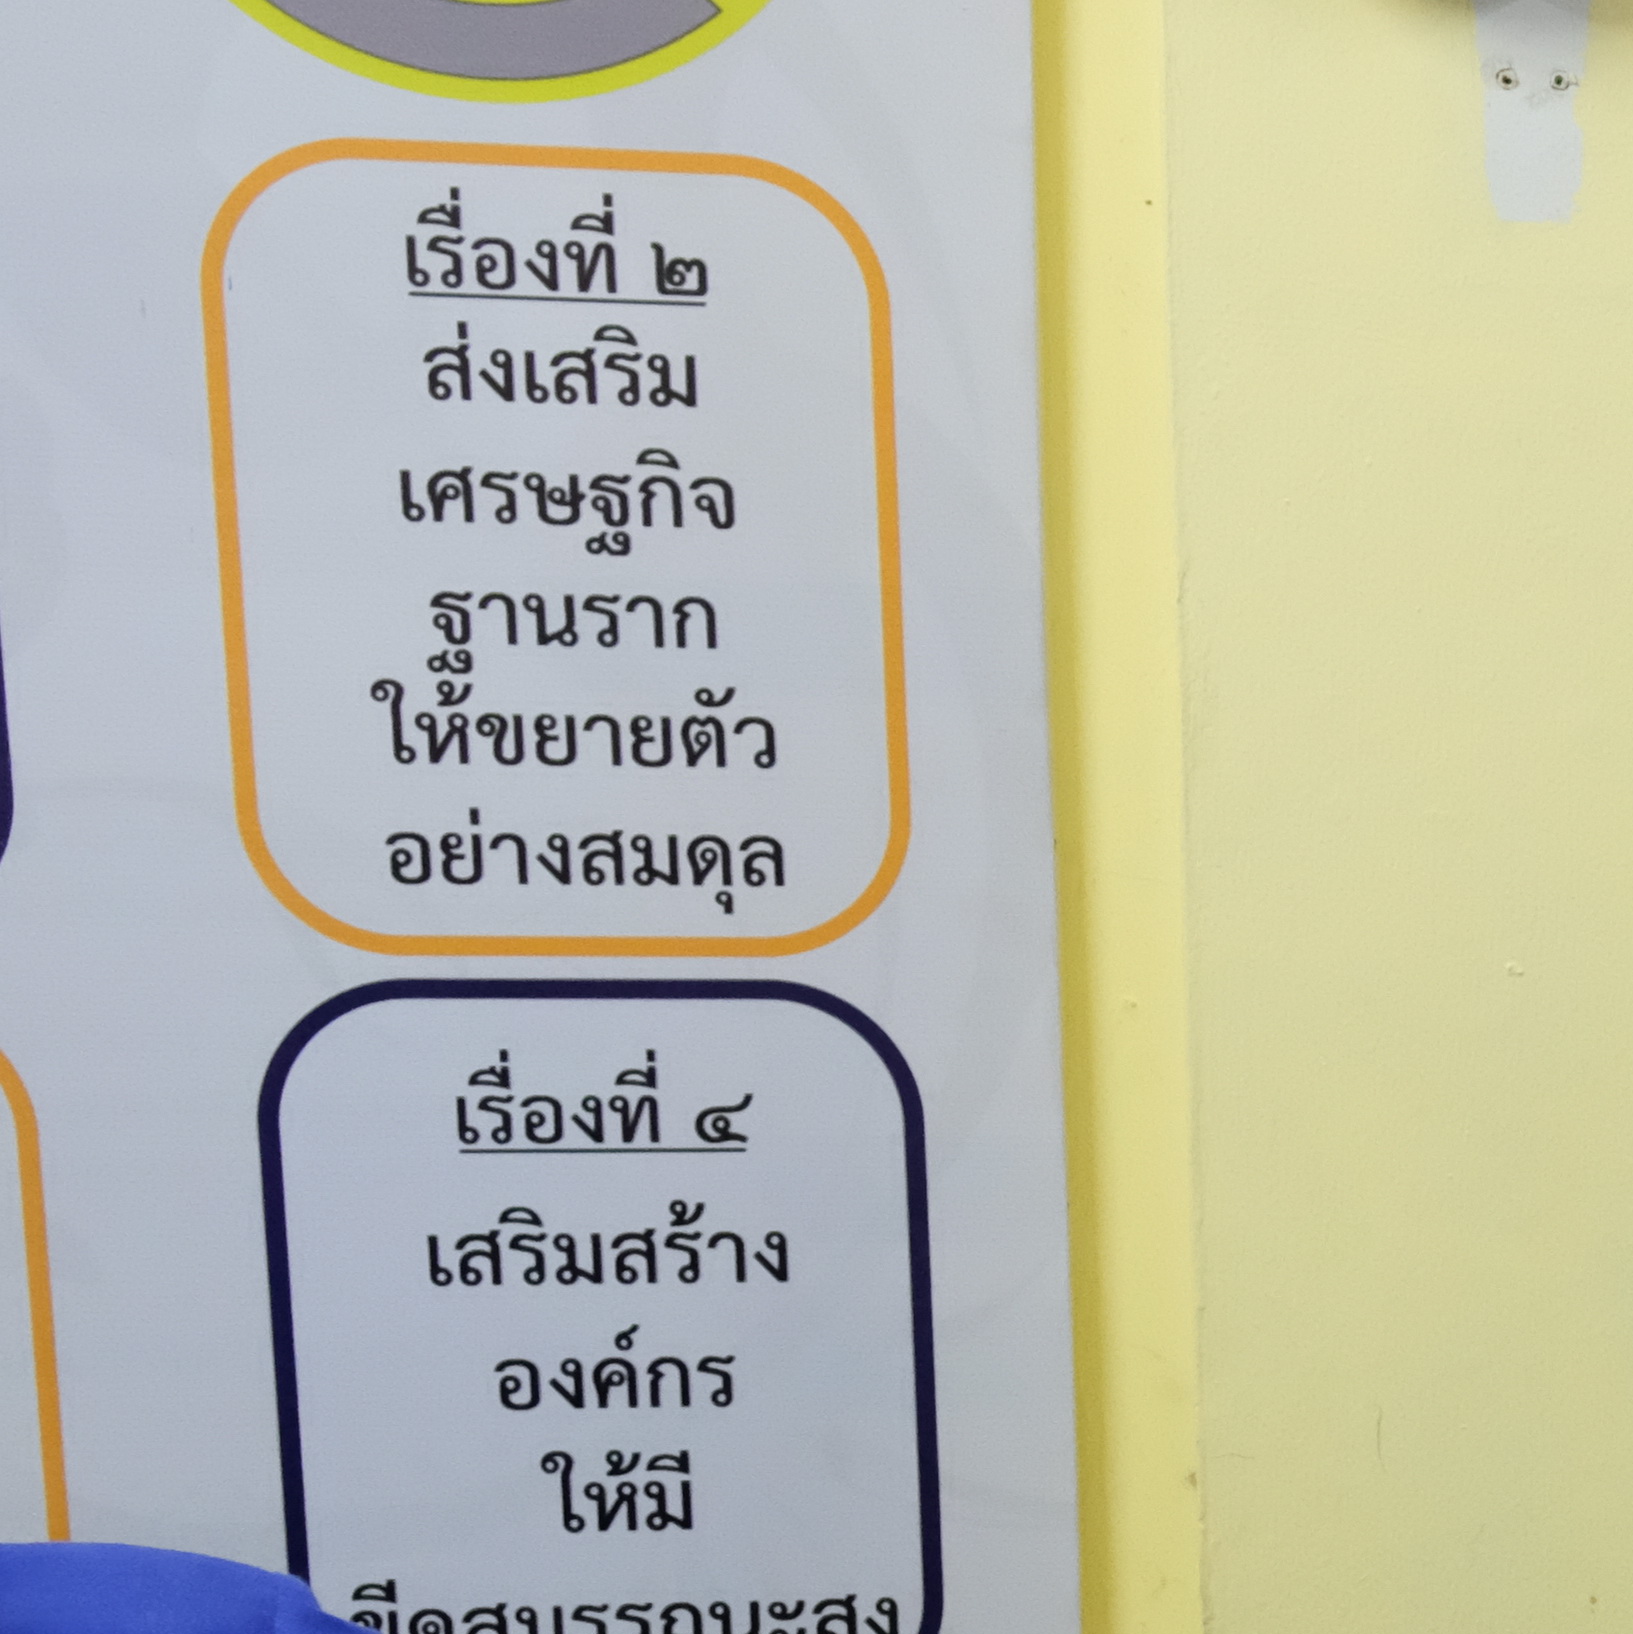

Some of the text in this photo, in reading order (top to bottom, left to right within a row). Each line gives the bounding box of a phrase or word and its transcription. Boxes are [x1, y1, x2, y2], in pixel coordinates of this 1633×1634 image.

[403, 188, 709, 298] เรื่องที่ ๒
[424, 321, 700, 408] ส่งเสริม
[398, 450, 738, 558] เศรษฐกิจ
[427, 588, 718, 674] ฐานราก
[370, 680, 779, 771] ให้ขยายตัว
[385, 810, 788, 914] อย่างสมดุล
[455, 1050, 755, 1147] เรื่องที่ ๔
[426, 1200, 793, 1288] เสริมสร้าง
[494, 1325, 736, 1411] องค์กร
[541, 1451, 694, 1535] ให้มี
